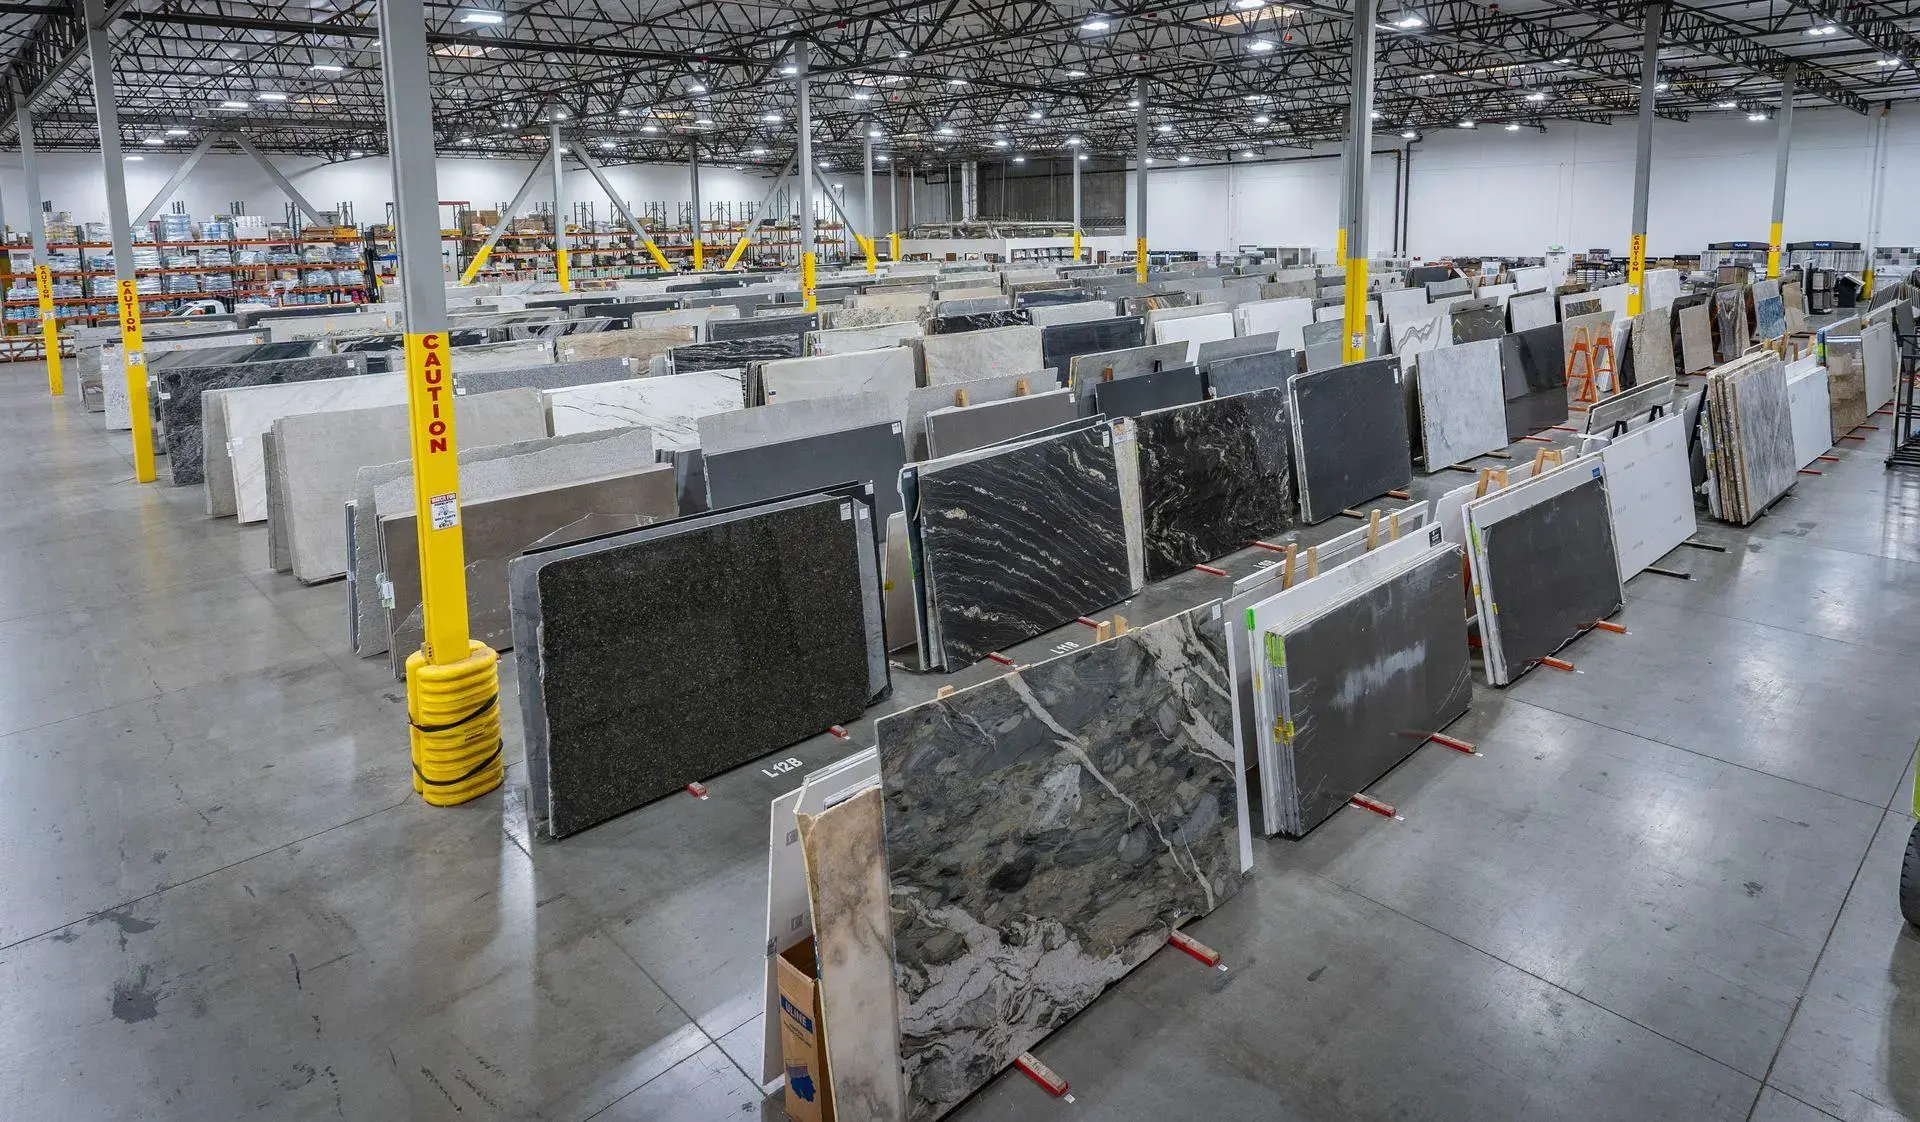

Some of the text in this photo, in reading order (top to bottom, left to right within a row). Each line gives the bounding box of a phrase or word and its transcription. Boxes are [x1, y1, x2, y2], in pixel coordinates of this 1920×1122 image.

[40, 266, 49, 298] CAUTION
[122, 281, 136, 332] CAUTION
[422, 334, 448, 454] CAUTION
[1050, 641, 1080, 655] L11B
[761, 757, 803, 778] L12B
[785, 1000, 808, 1029] ULINE
